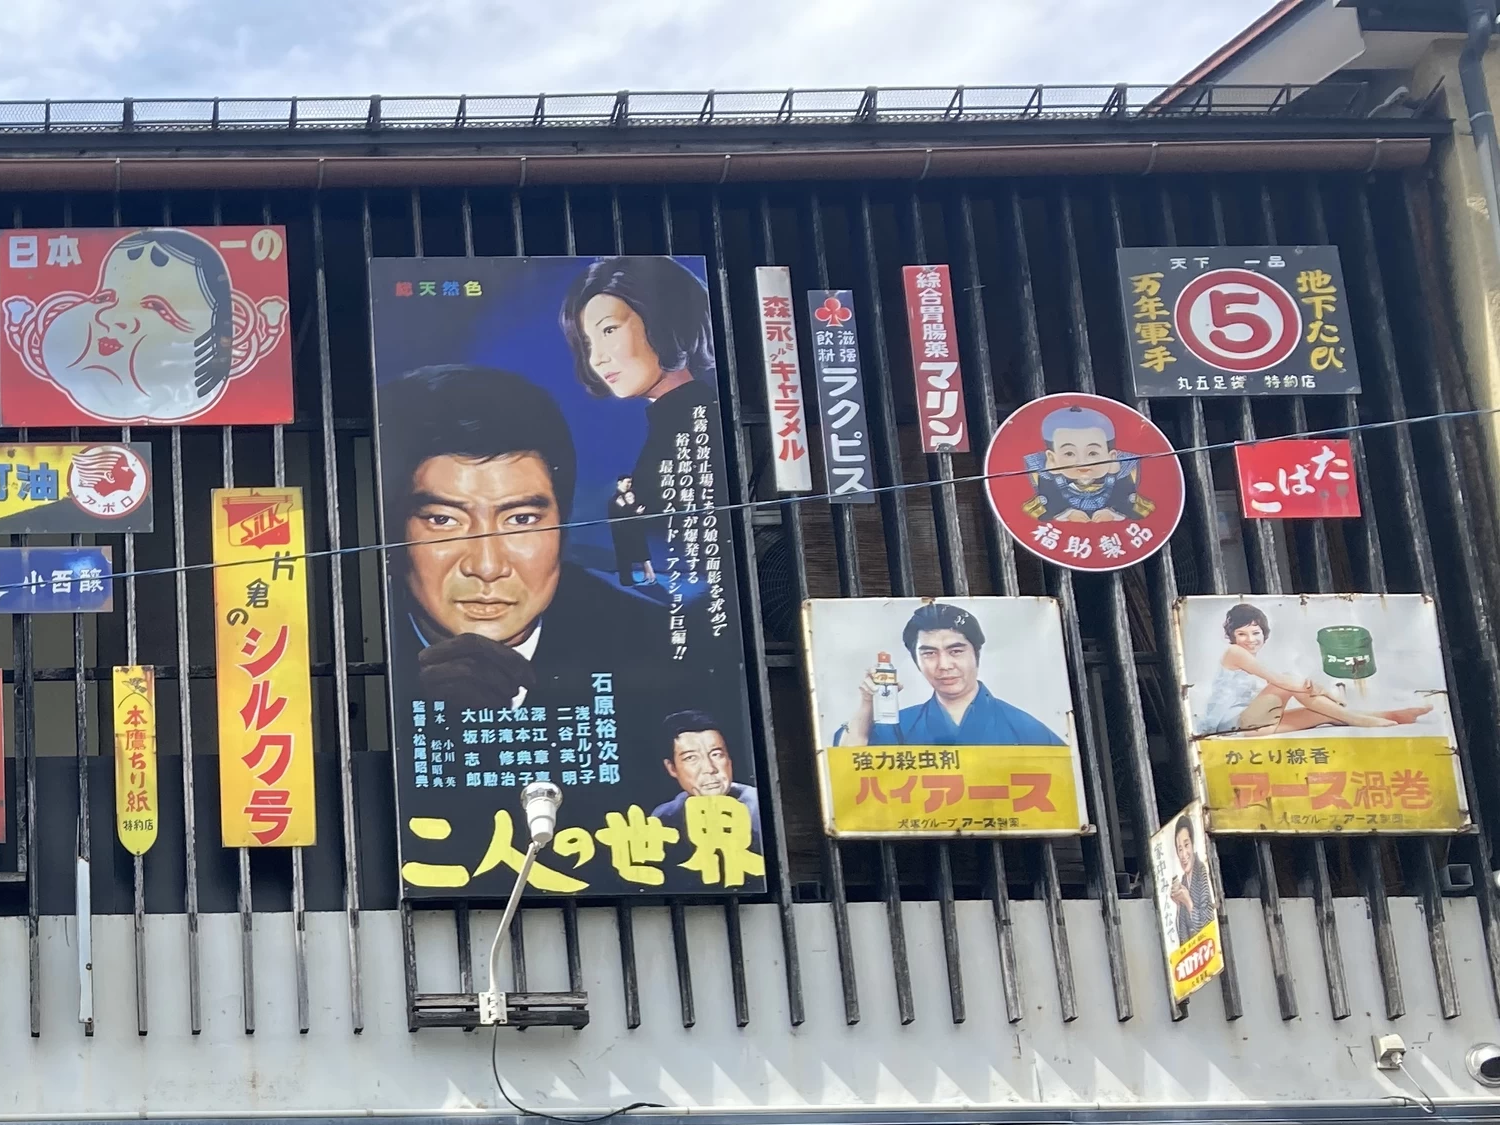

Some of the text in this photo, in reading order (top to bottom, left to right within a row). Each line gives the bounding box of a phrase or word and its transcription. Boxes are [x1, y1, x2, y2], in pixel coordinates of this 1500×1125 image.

[8, 234, 82, 269] 日本
[219, 229, 284, 262] 一の
[1170, 257, 1210, 269] 天下
[1244, 255, 1286, 269] 一品
[1129, 272, 1177, 373] 万年軍手
[1209, 290, 1273, 353] 5
[1296, 269, 1345, 371] 地下たび
[920, 362, 963, 451] マリン
[1264, 375, 1316, 389] 特約店
[822, 367, 868, 495] ラクピス
[82, 495, 134, 513] アポロ
[1032, 523, 1153, 559] 福助製品
[237, 625, 293, 846] シルク号
[513, 707, 534, 787] 松本典子
[557, 707, 578, 786] 二谷英明
[575, 706, 596, 785] 浅丘ルリ子
[591, 673, 620, 785] 石原裕次郎
[122, 705, 151, 813] 本鷹ちり紙
[852, 750, 960, 771] 強力殺虫剤
[1225, 748, 1330, 765] かとり線香
[855, 773, 1056, 813] ハイアース
[1229, 769, 1434, 810] アース渦巻
[122, 819, 154, 831] 特約店
[402, 795, 765, 892] 二人の世界
